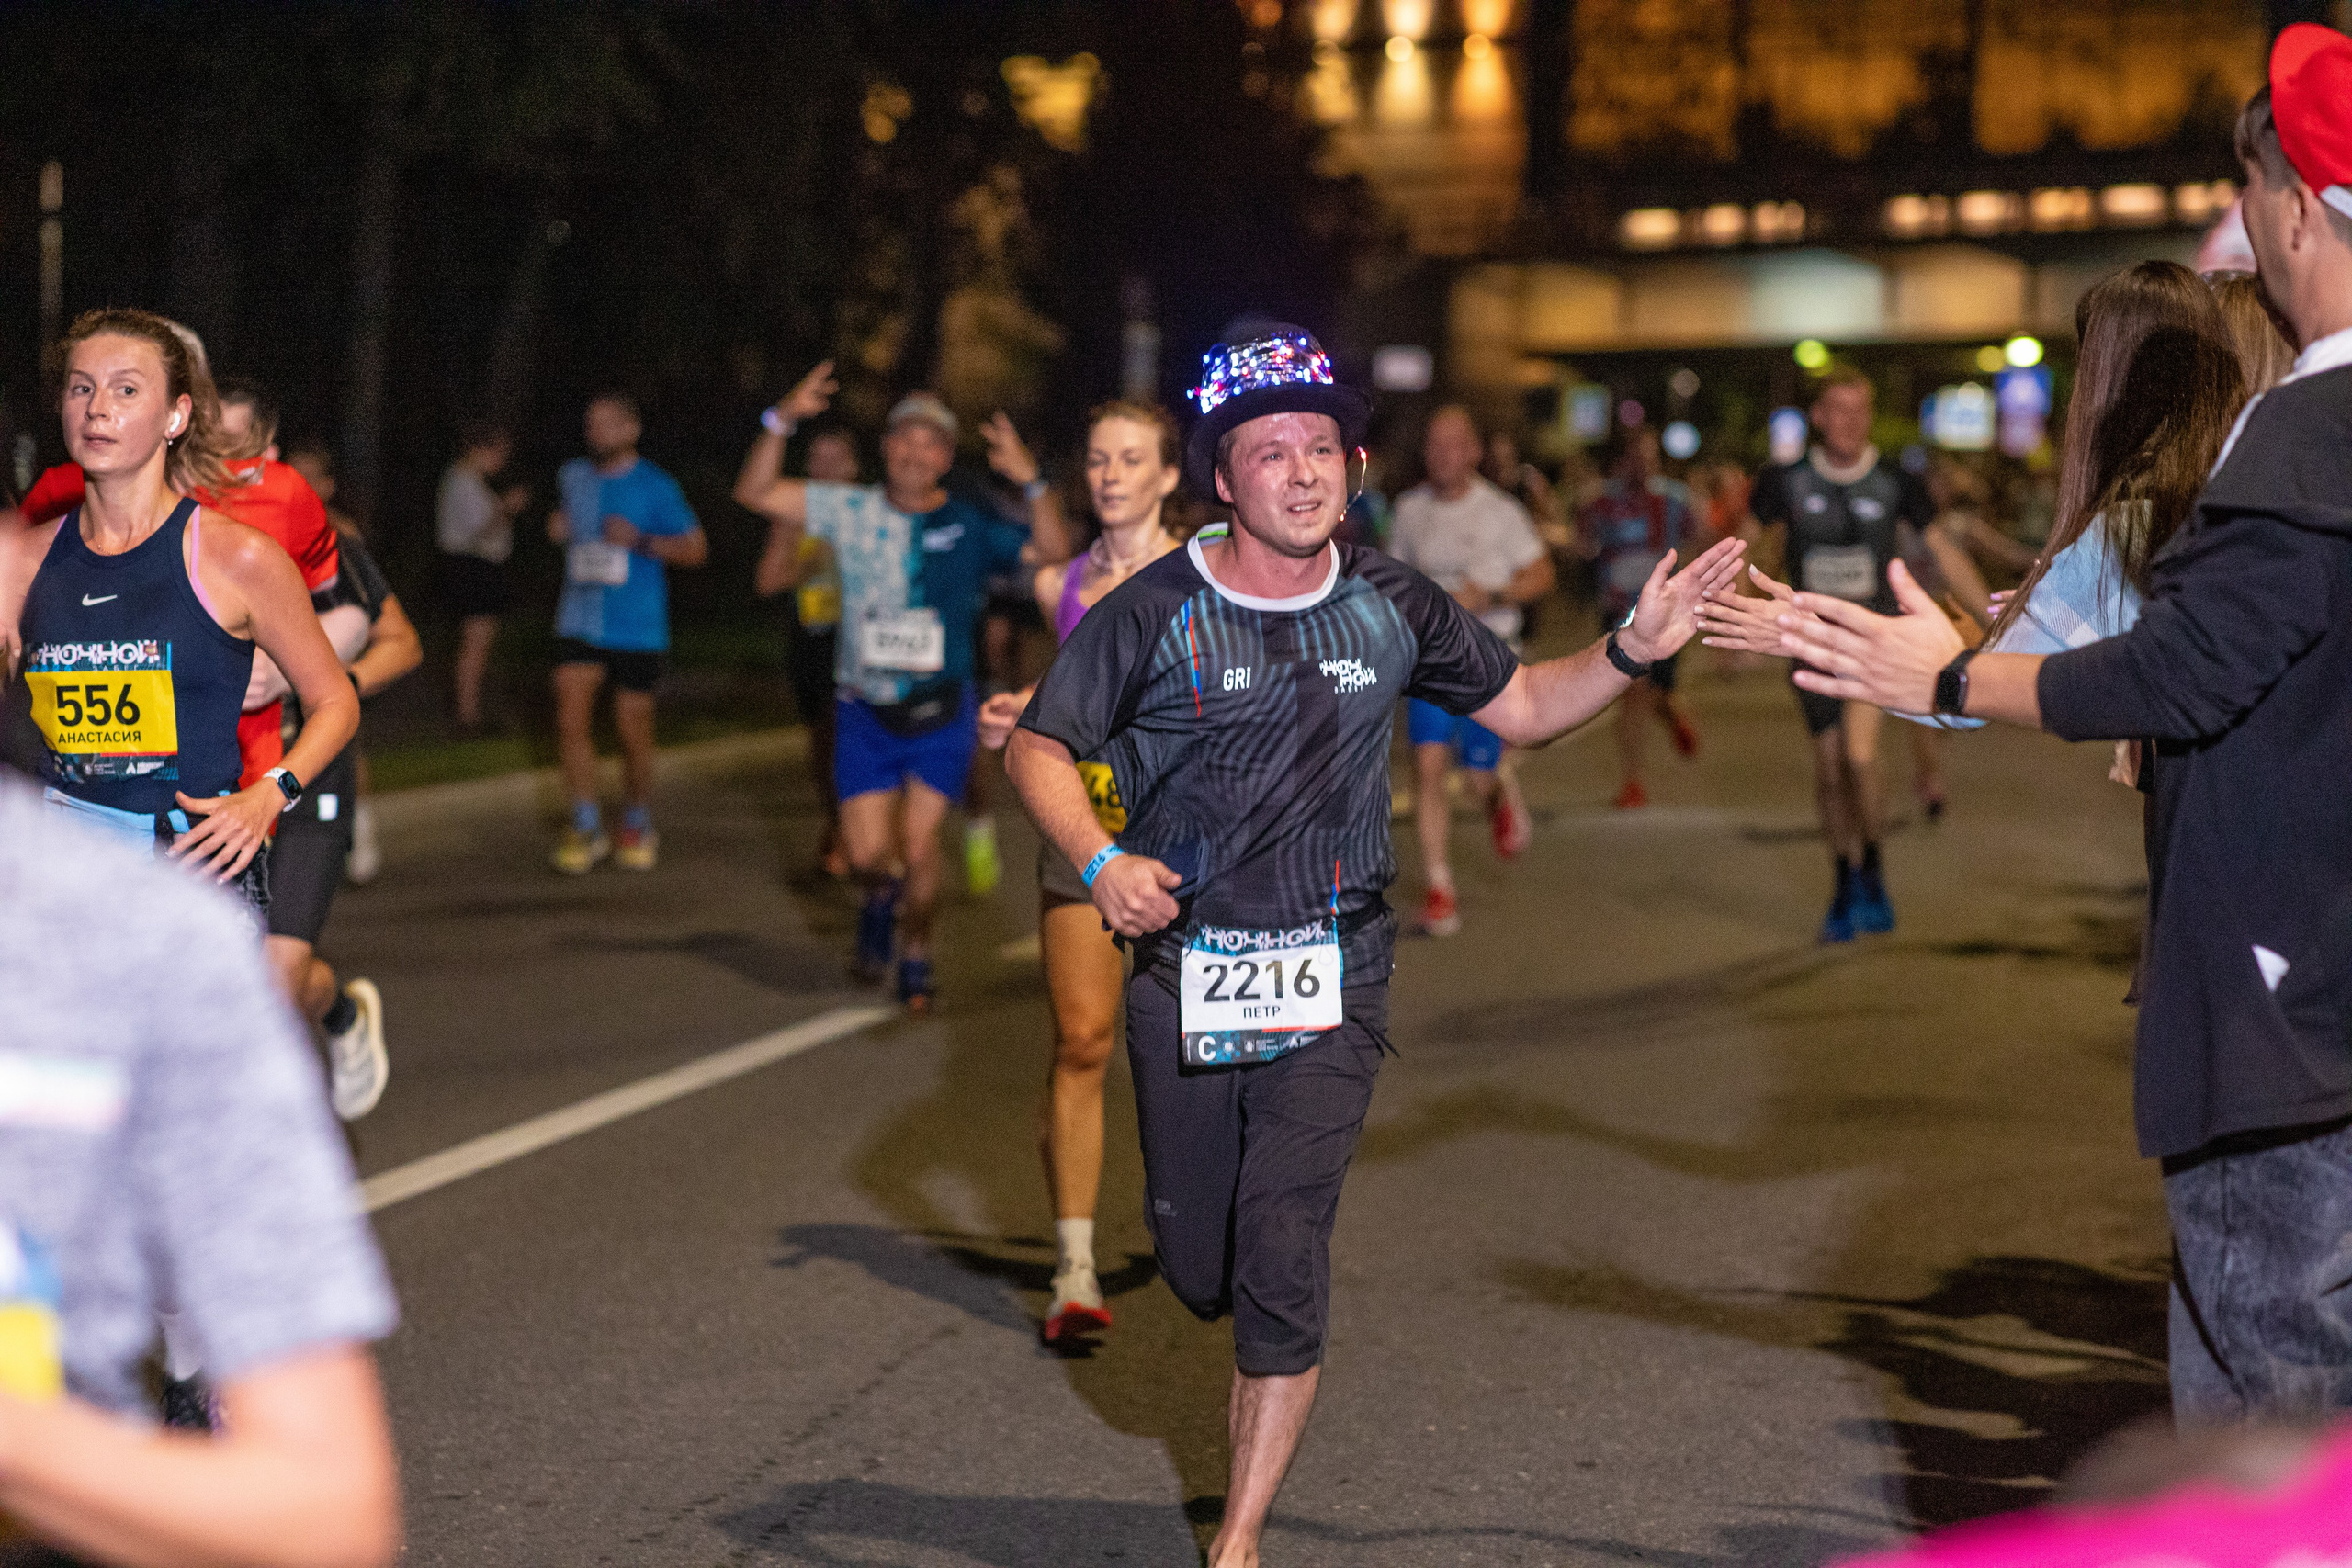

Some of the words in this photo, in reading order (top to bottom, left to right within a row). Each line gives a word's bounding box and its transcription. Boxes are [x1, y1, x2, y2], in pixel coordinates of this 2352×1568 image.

[56, 684, 141, 727] 556
[58, 731, 141, 744] АНАСТАСИЯ
[1203, 959, 1321, 1003] 2216
[1243, 1006, 1281, 1019] ПЕТР
